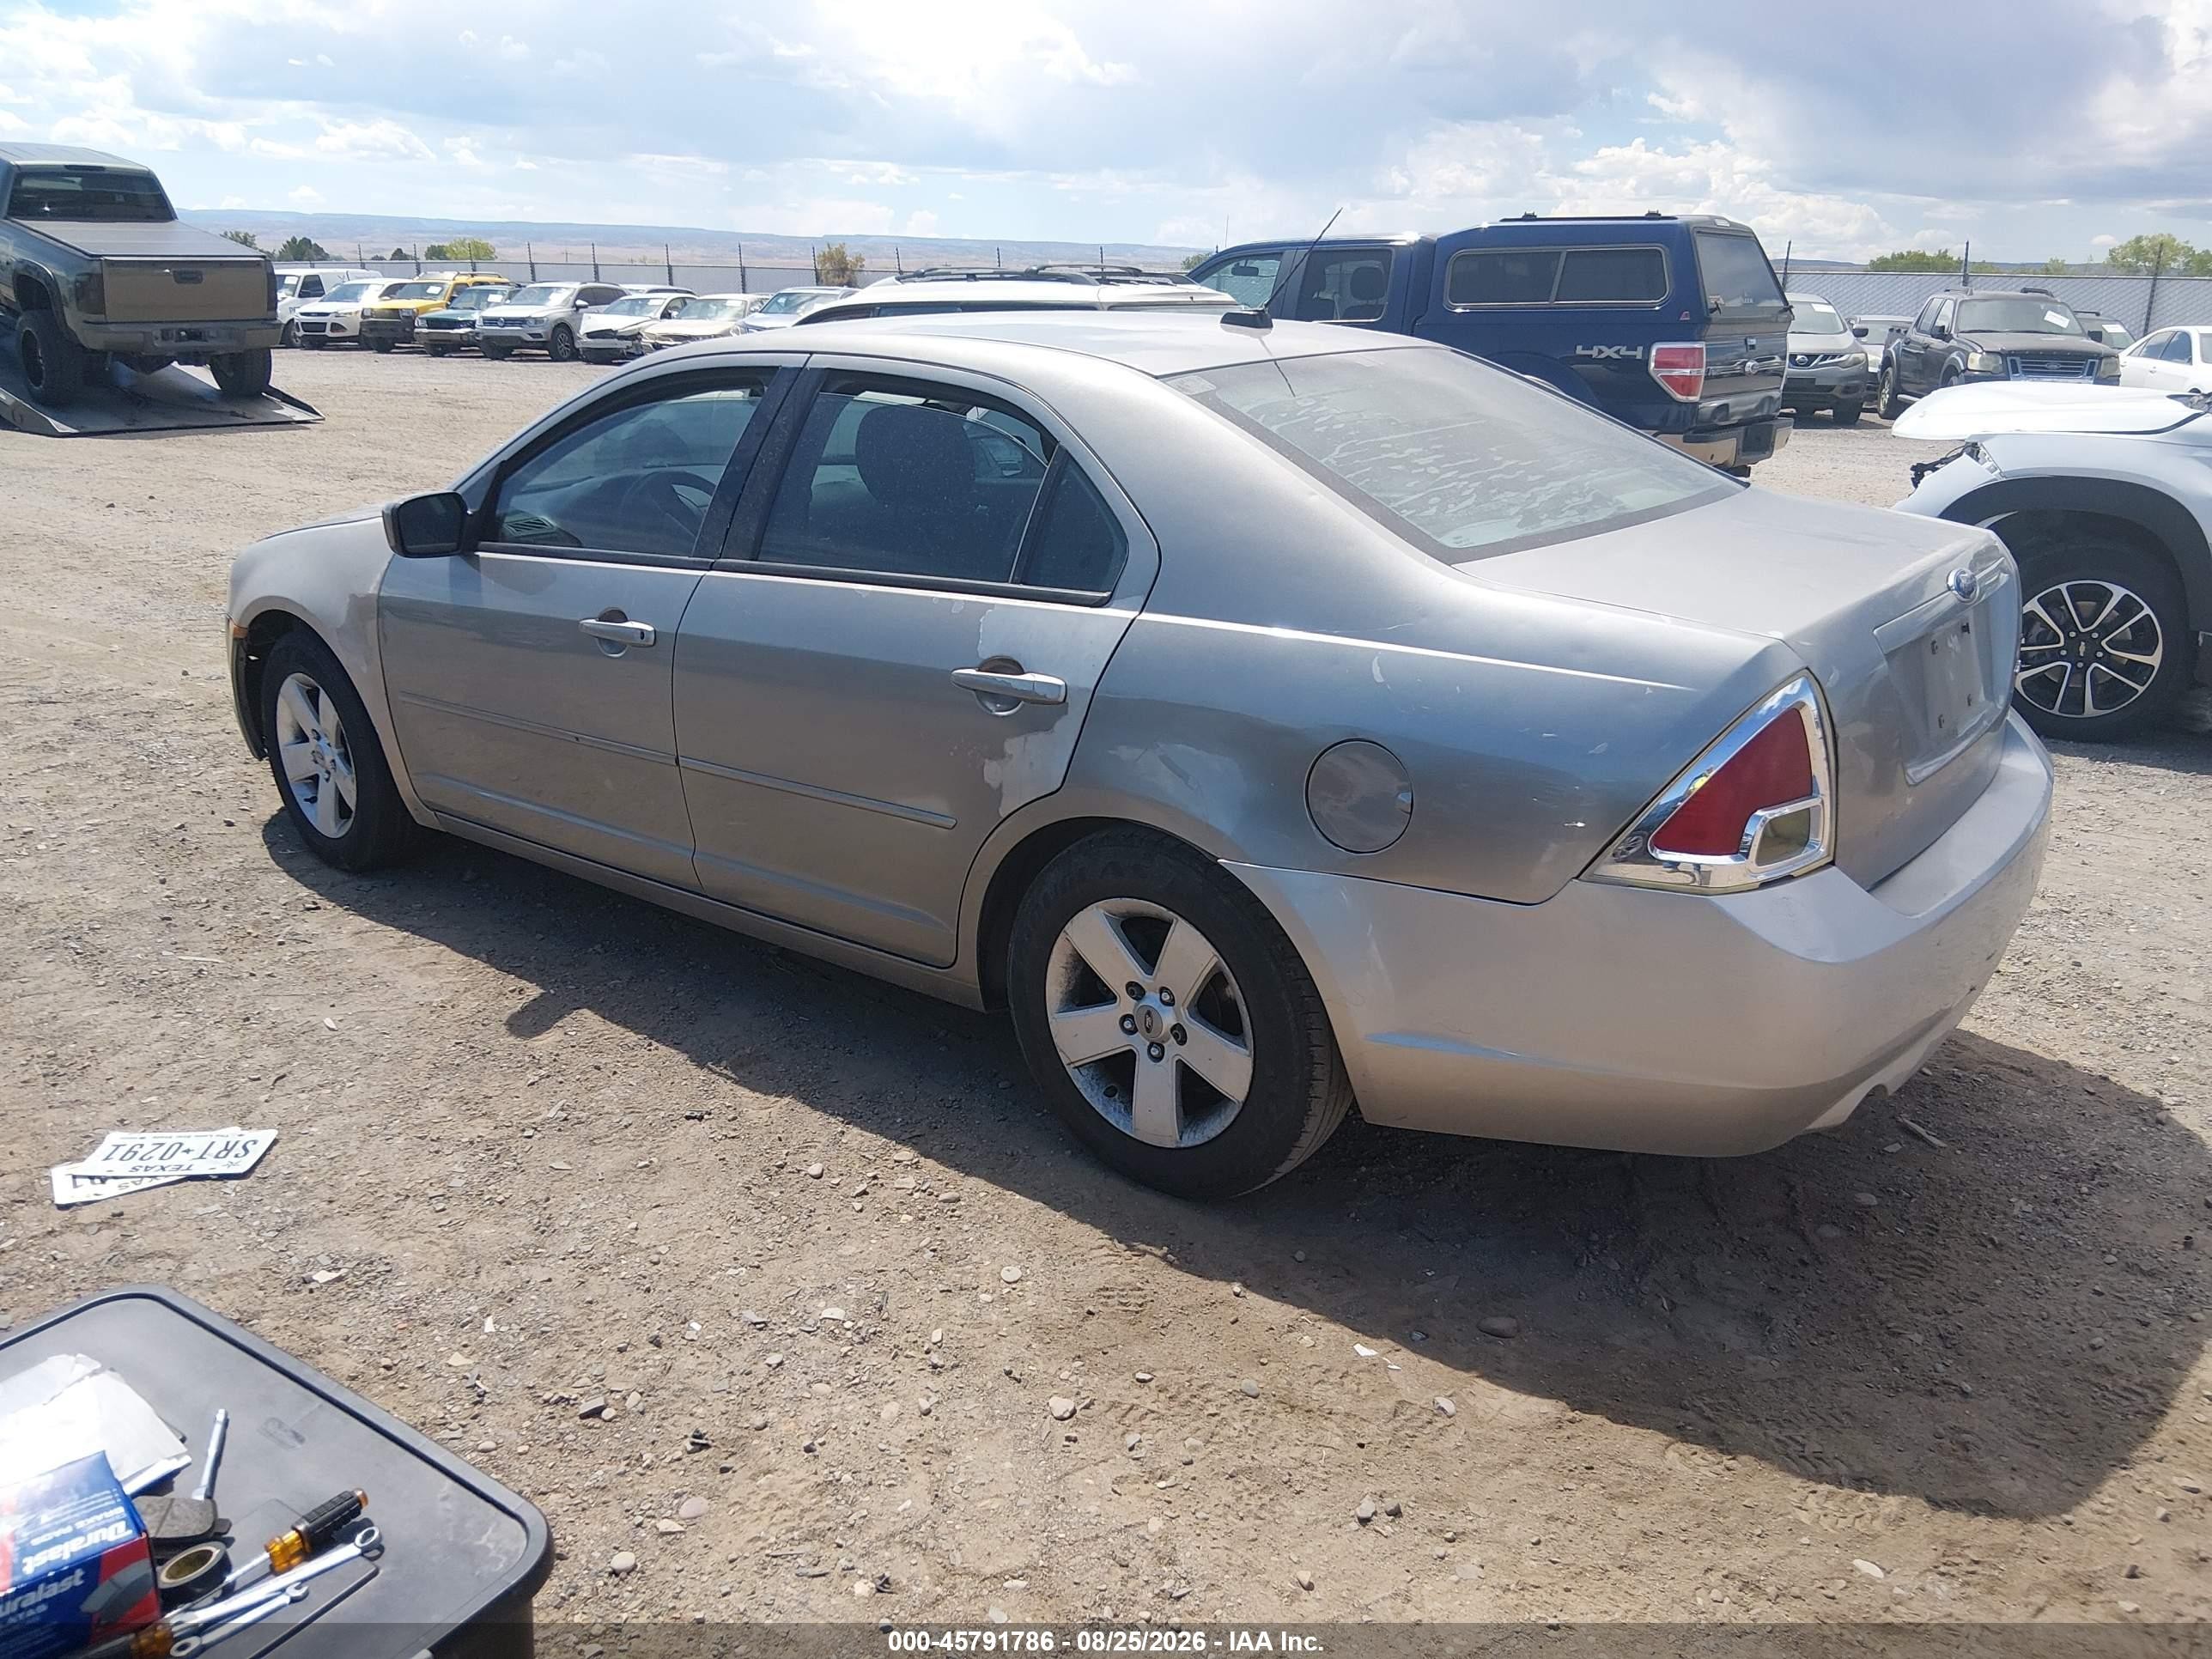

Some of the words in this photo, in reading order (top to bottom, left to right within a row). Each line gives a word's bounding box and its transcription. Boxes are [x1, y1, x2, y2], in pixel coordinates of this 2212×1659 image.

[129, 1164, 195, 1173] TEXAS
[21, 1520, 133, 1576] Duralast
[0, 1567, 86, 1619] uralast
